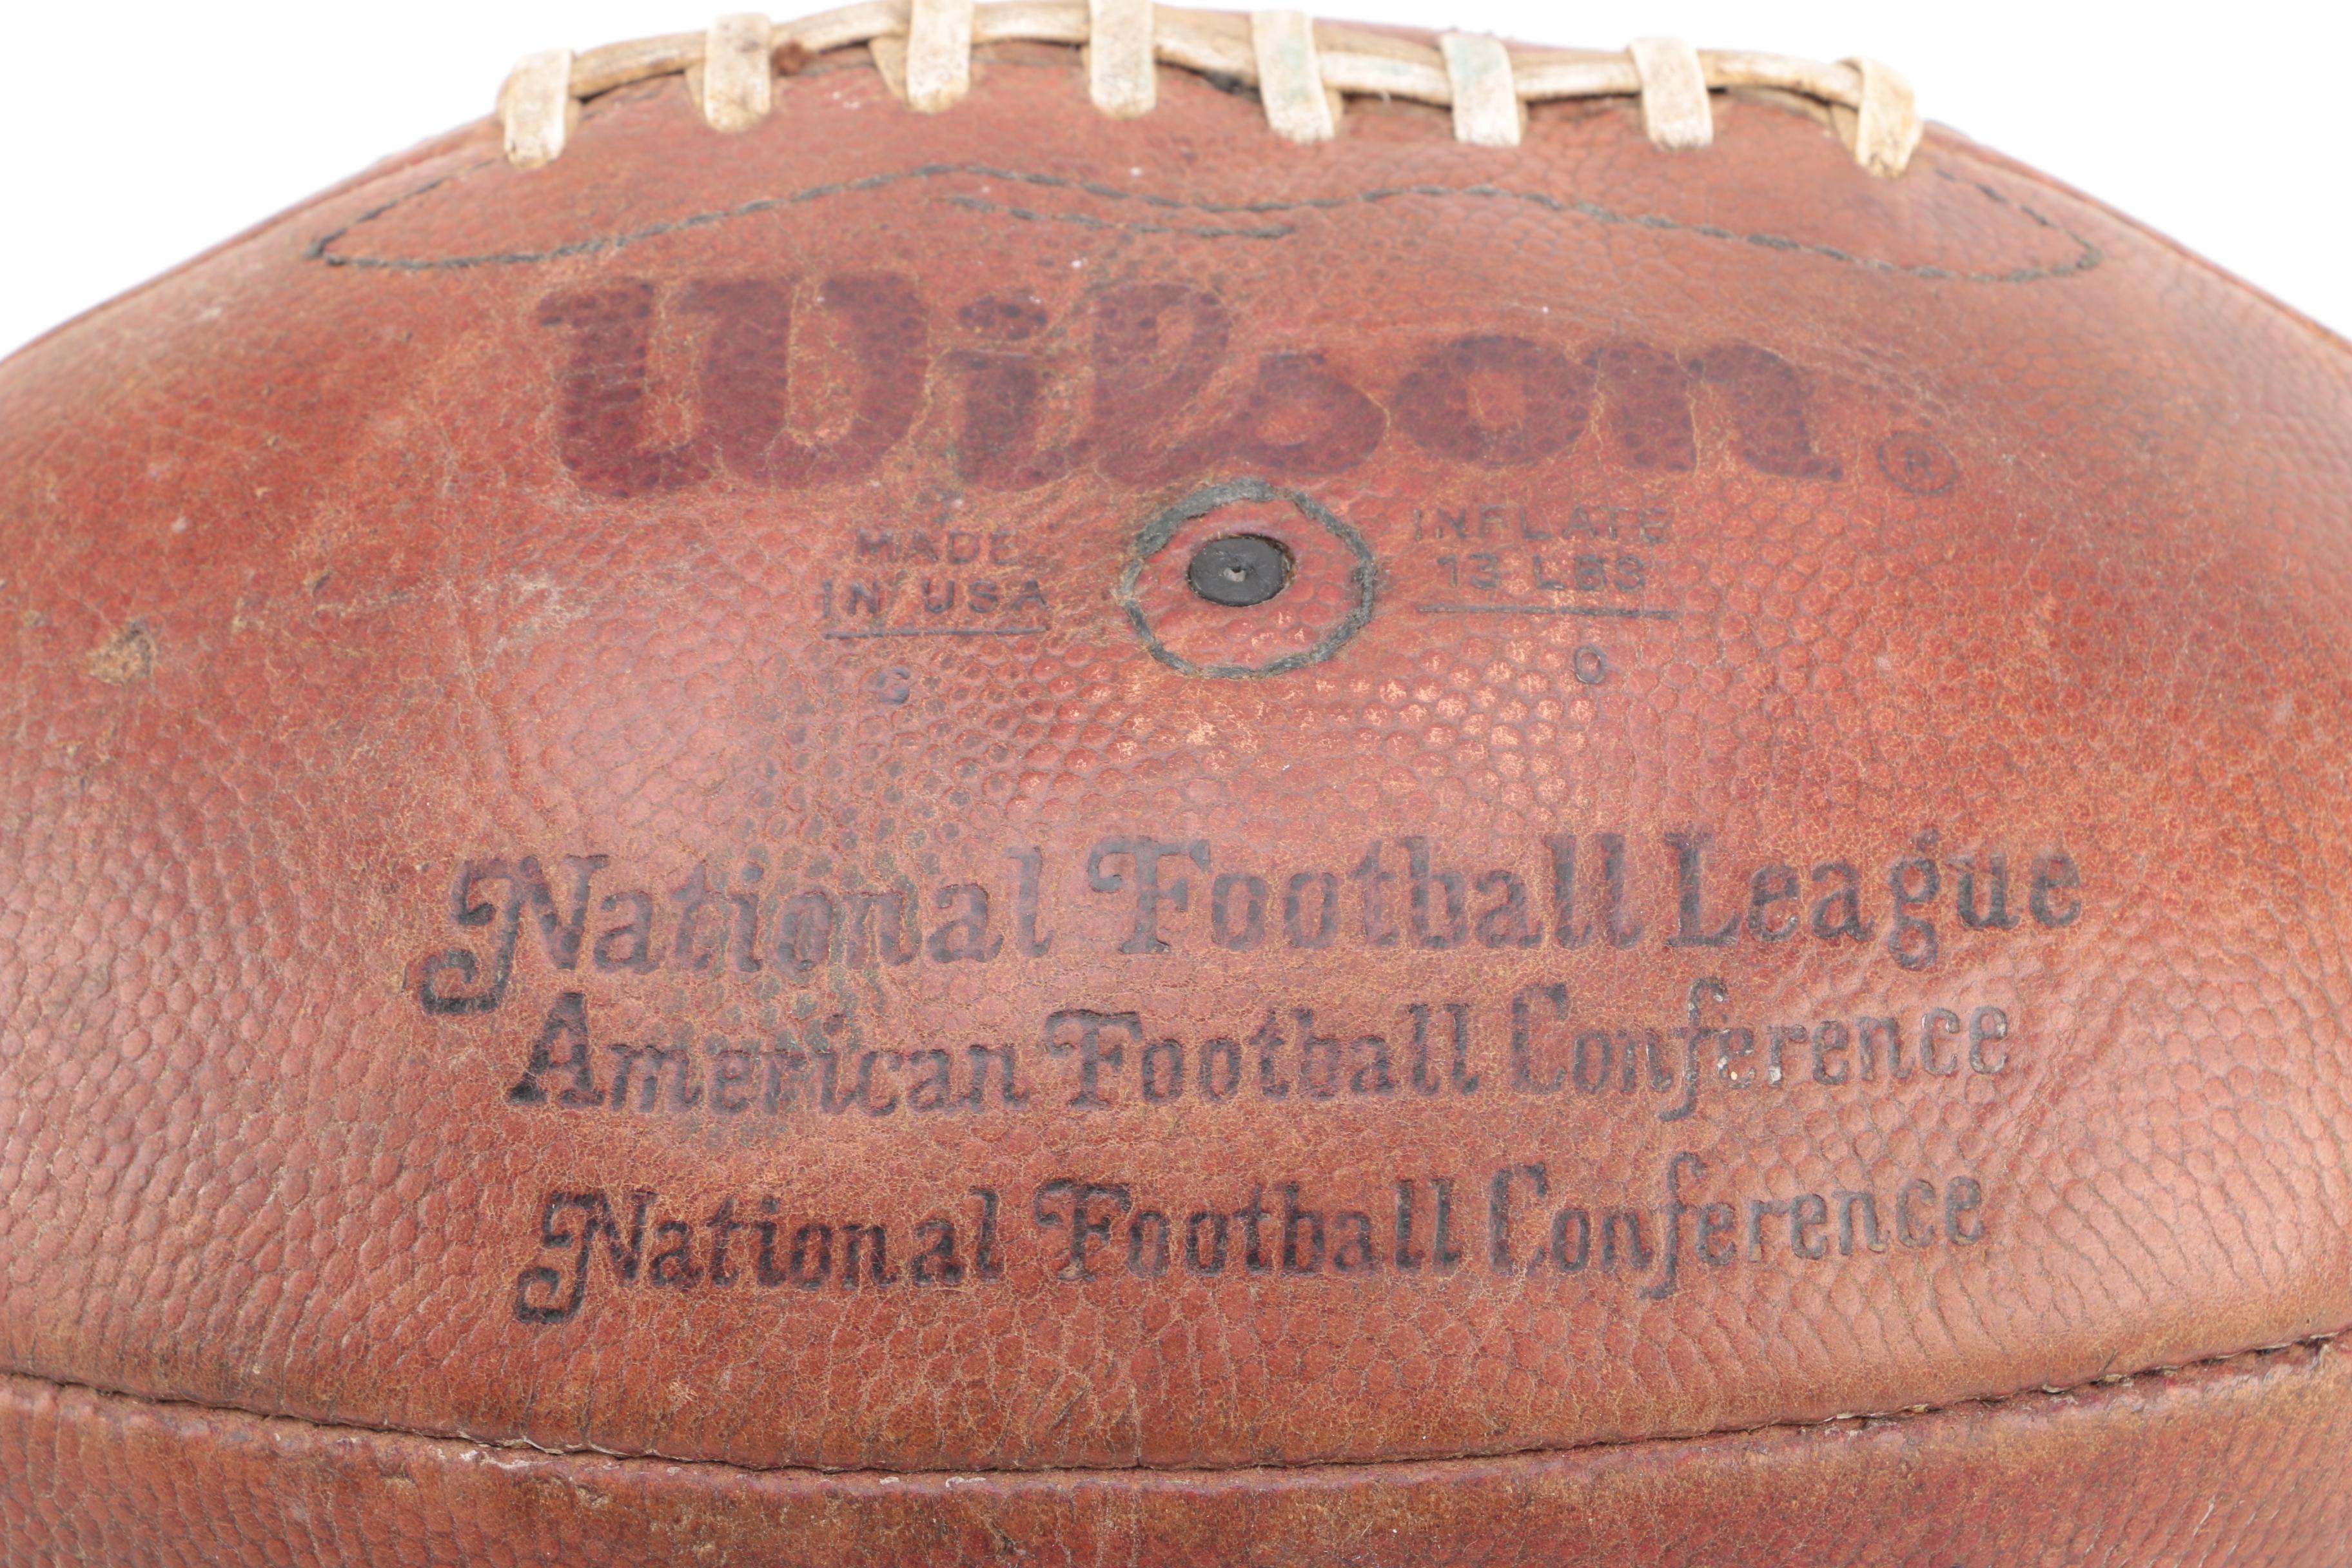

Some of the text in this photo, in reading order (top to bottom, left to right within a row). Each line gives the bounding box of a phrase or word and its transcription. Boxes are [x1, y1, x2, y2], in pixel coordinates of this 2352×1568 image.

[537, 271, 1843, 500] Wilson
[856, 529, 1019, 565] MADE
[1413, 504, 1669, 543] INFLATE
[823, 578, 1049, 618] IN USA
[1436, 553, 1646, 593] 13 LBS
[414, 827, 2083, 1016] National Football League
[507, 975, 2008, 1122] American Football Conference
[514, 1150, 1986, 1325] National Football Conference
